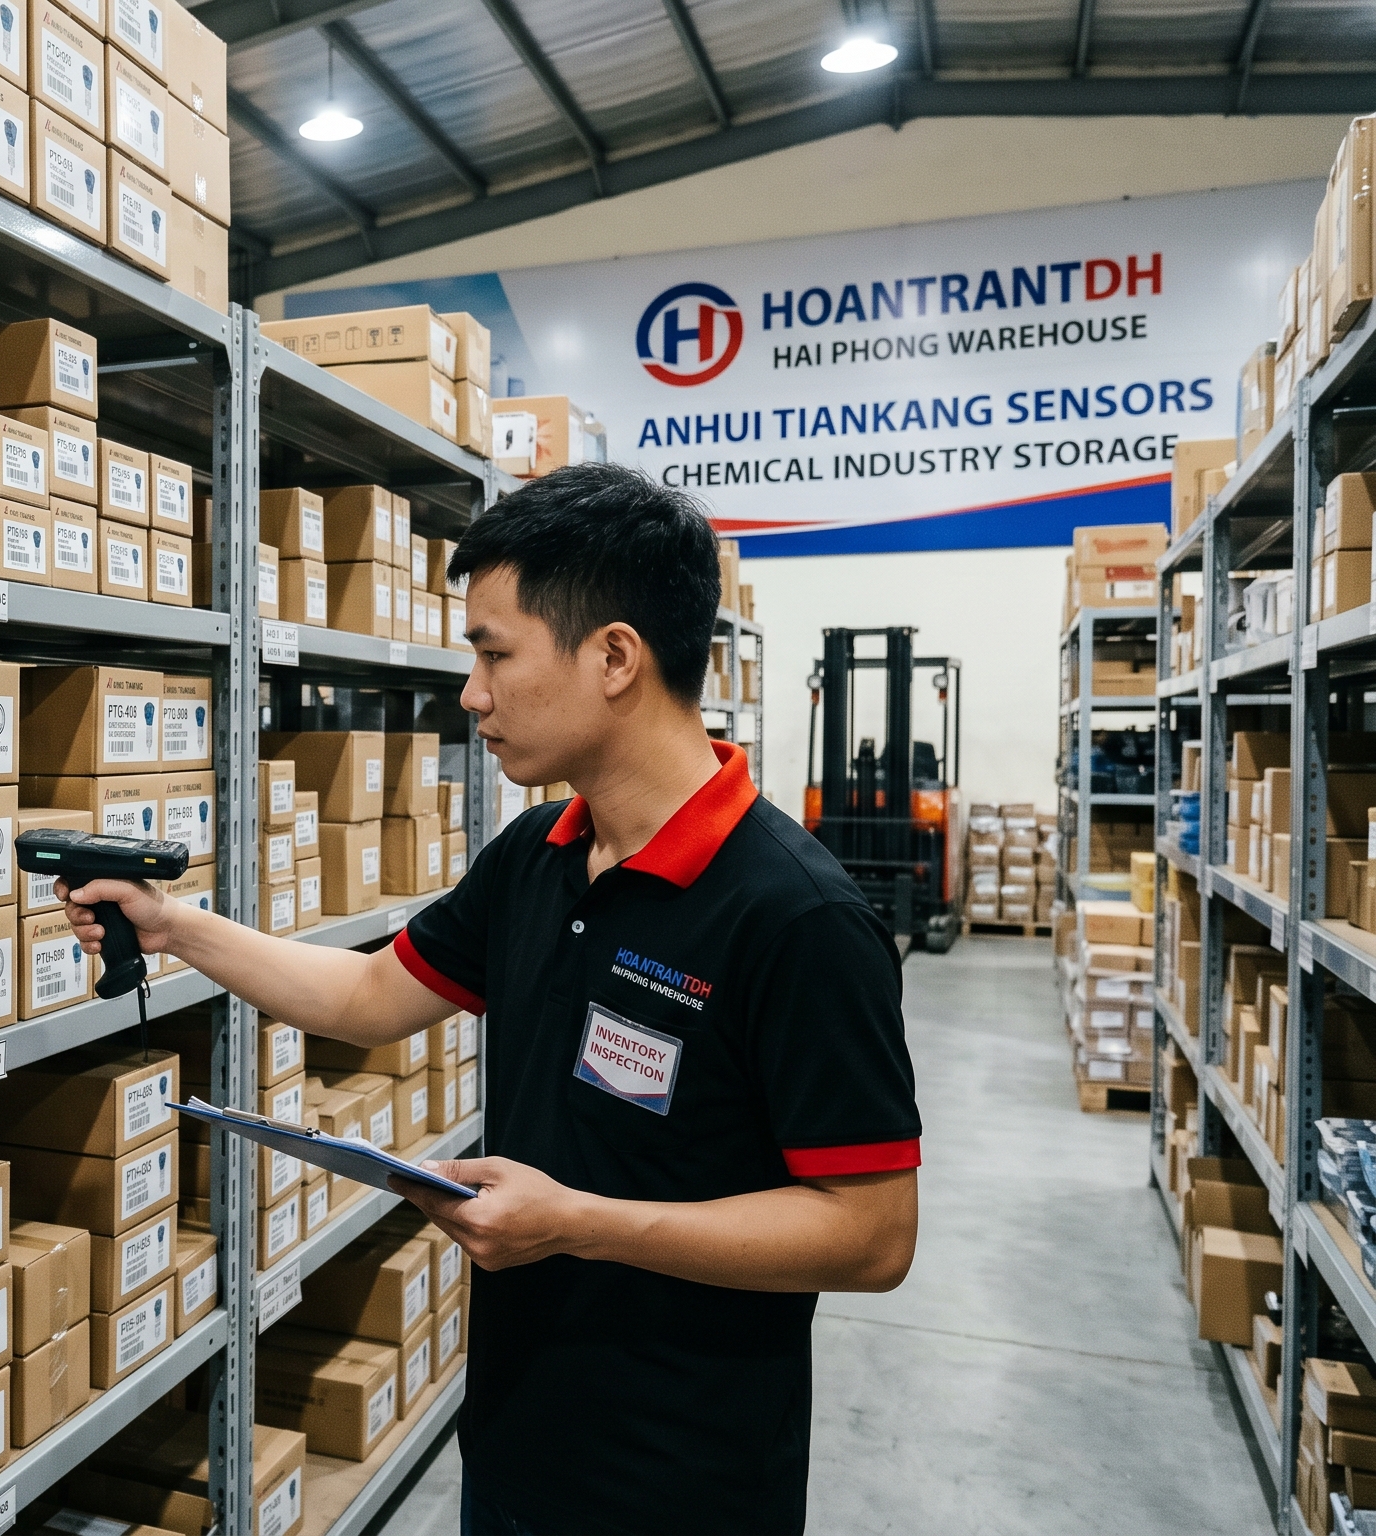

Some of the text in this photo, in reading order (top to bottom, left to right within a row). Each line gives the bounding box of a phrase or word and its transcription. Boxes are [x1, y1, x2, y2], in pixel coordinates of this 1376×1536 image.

[762, 252, 1164, 331] HOANTRANTDH
[773, 314, 1149, 370] HAI PHONG WAREHOUSE
[637, 377, 1216, 449] ANHUI TIANKANG SENSORS
[661, 433, 1180, 489] CHEMICAL INDUSTRY STORAGE
[590, 1041, 665, 1083] INSPECTION
[595, 1024, 667, 1064] INVENTORY
